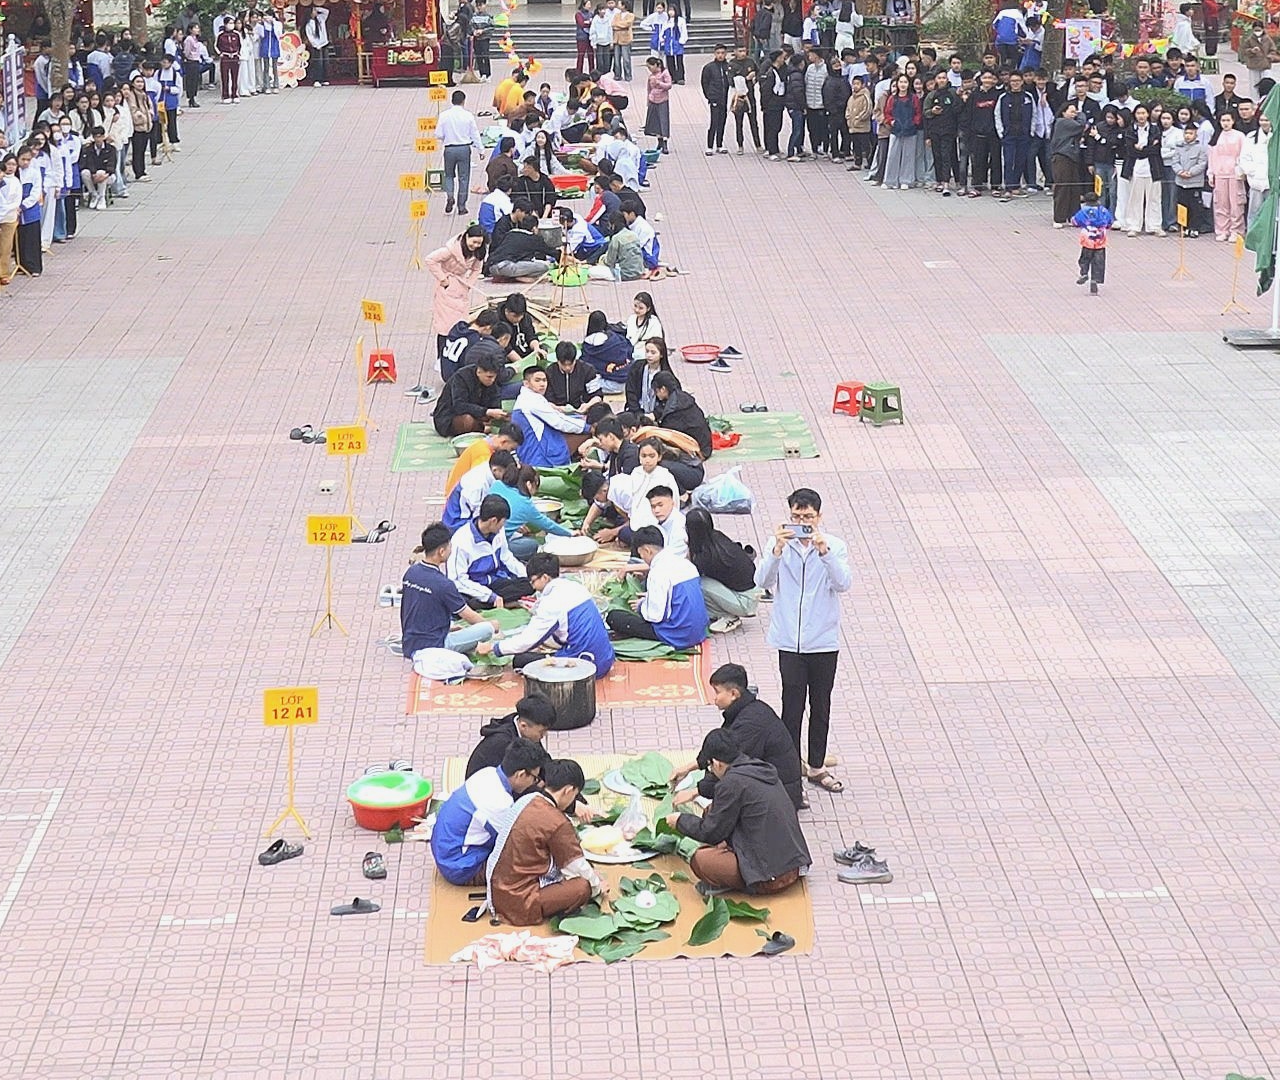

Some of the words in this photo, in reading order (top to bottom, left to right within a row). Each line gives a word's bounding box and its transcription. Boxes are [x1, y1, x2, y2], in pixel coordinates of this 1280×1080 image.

[364, 311, 372, 320] 12
[332, 441, 345, 451] 12
[348, 440, 362, 450] A3
[312, 531, 327, 542] 12
[330, 531, 346, 542] A2
[281, 692, 304, 705] LỚP
[272, 707, 290, 720] 12
[295, 706, 313, 719] A1
